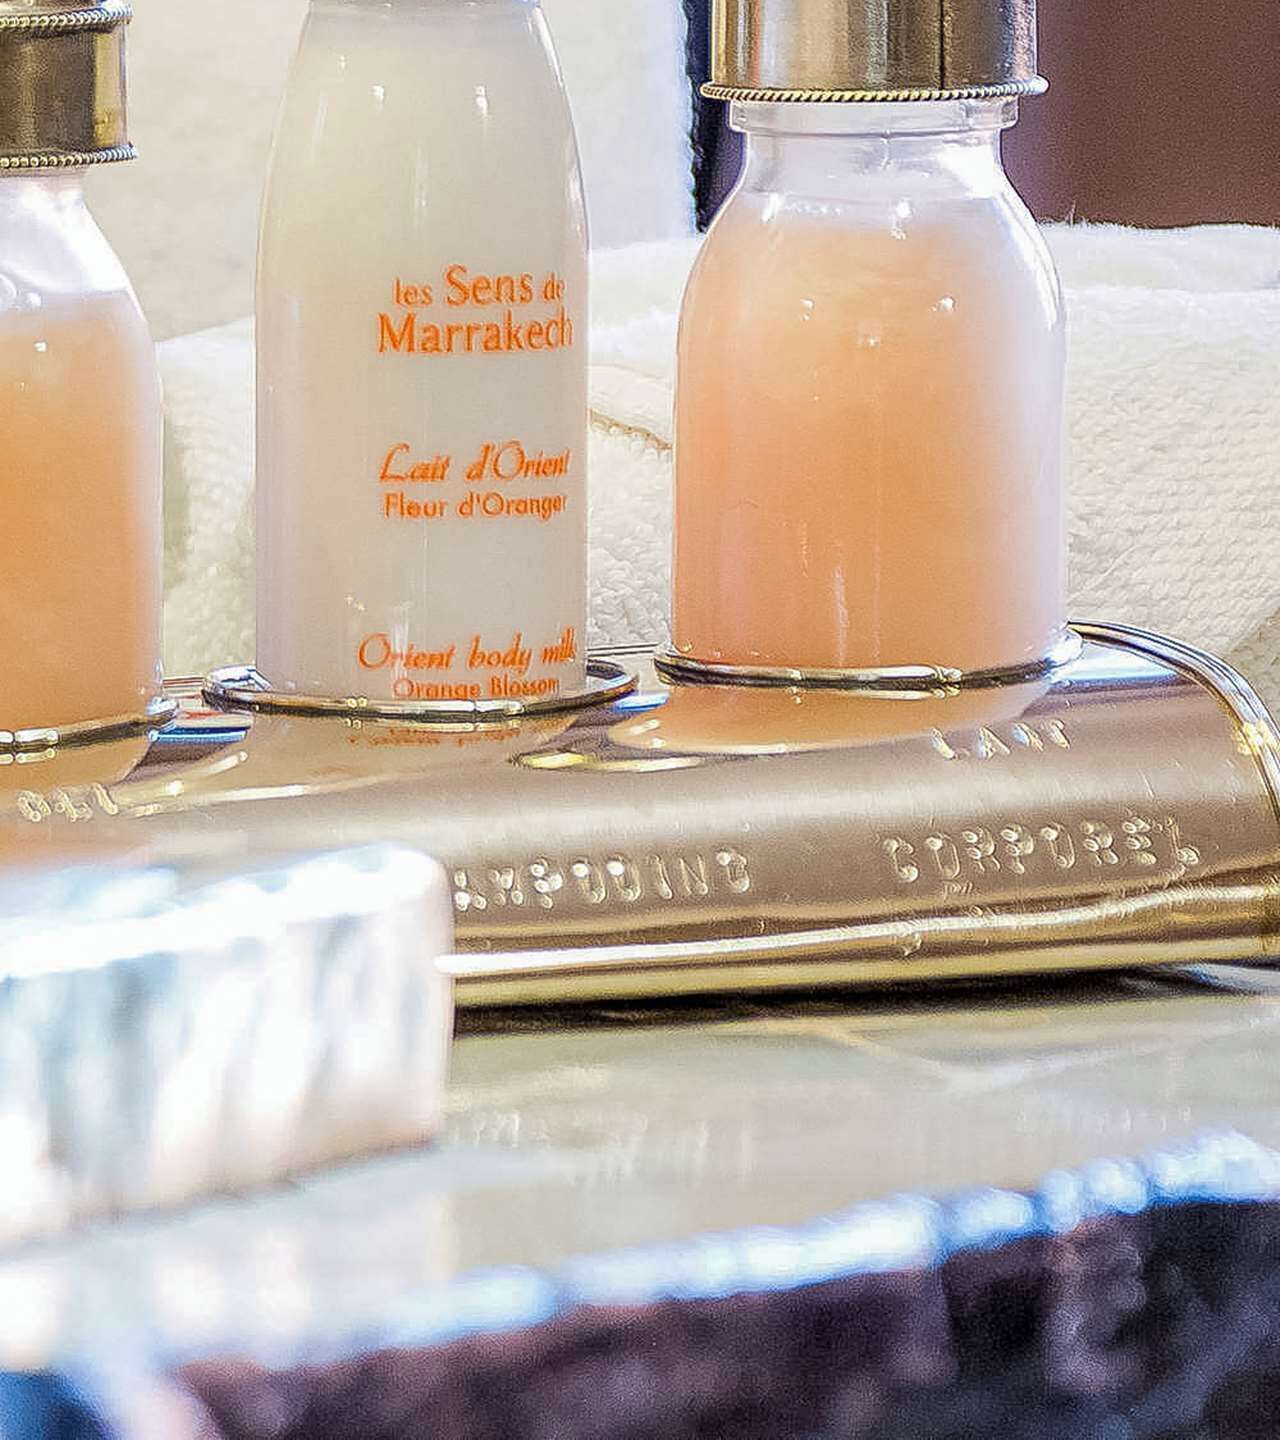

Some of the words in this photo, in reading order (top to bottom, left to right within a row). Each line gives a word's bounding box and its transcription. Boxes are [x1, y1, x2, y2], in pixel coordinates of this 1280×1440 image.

[394, 276, 433, 306] les
[443, 263, 534, 307] Sens
[543, 271, 566, 302] de
[376, 306, 574, 354] Marrakech
[379, 442, 451, 482] Lait
[464, 439, 571, 482] d'Orient
[383, 491, 447, 519] Fleur
[456, 490, 567, 521] d'Oranger
[357, 632, 456, 670] Orient
[466, 628, 534, 676] body
[394, 677, 481, 700] Orange
[490, 675, 561, 698] Blossom
